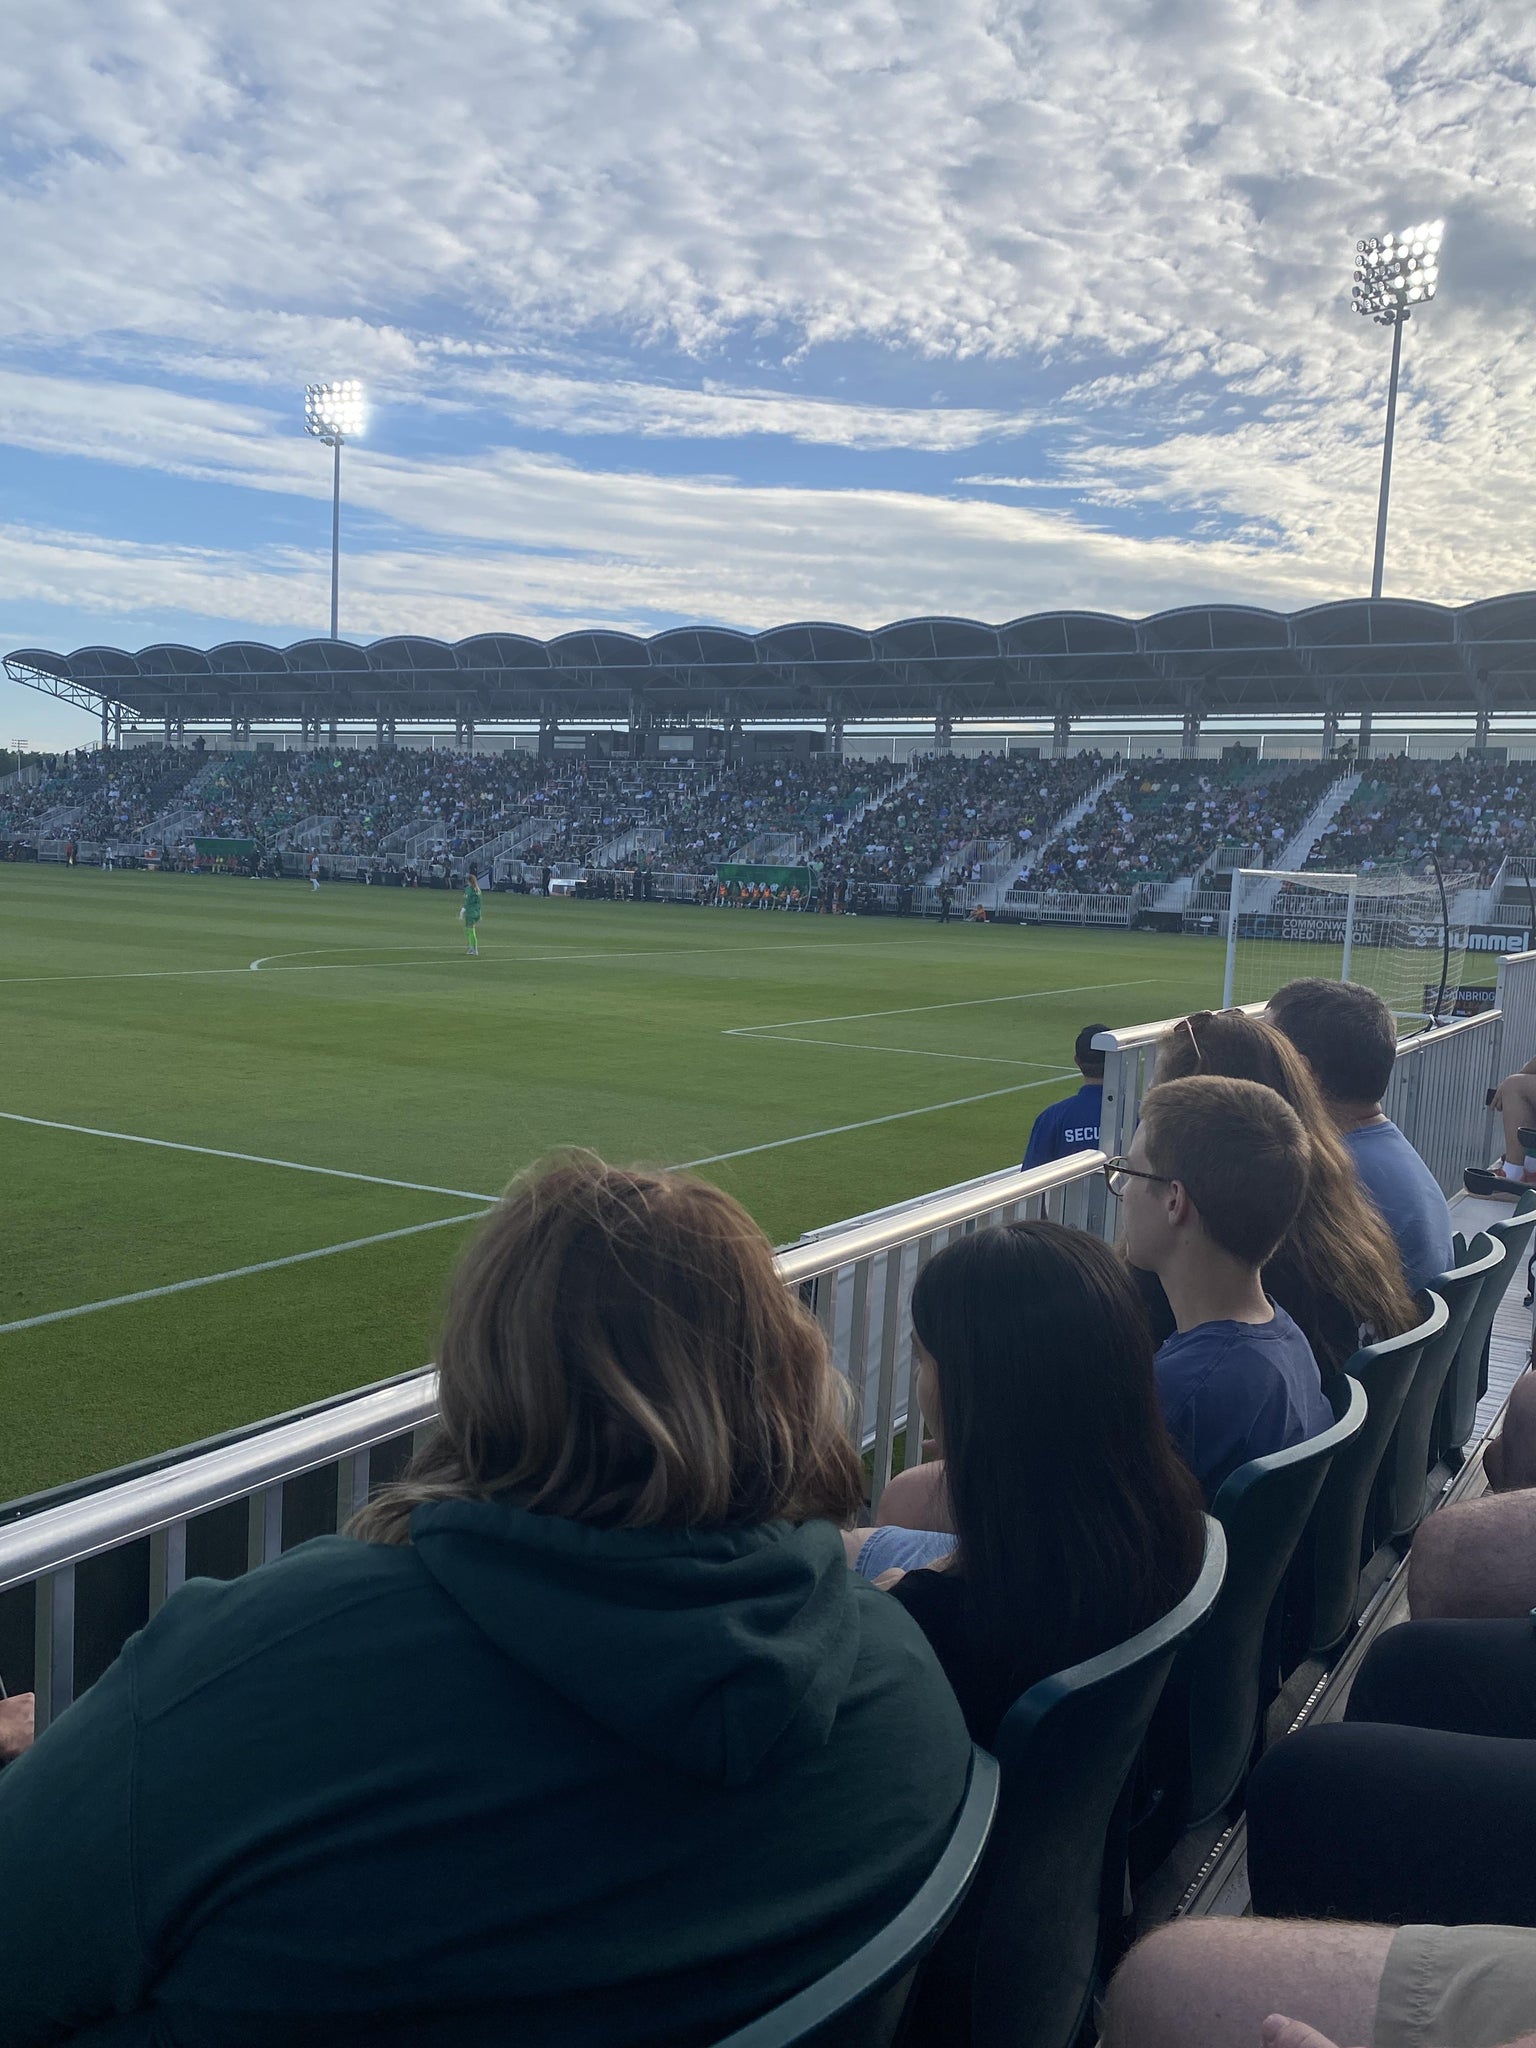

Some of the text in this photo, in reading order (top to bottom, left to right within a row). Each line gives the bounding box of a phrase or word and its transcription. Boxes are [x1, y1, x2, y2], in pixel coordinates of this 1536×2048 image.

[1282, 918, 1373, 932] COMMONWELTH
[1282, 928, 1372, 944] CREDIT UNON
[1438, 926, 1530, 952] hummel
